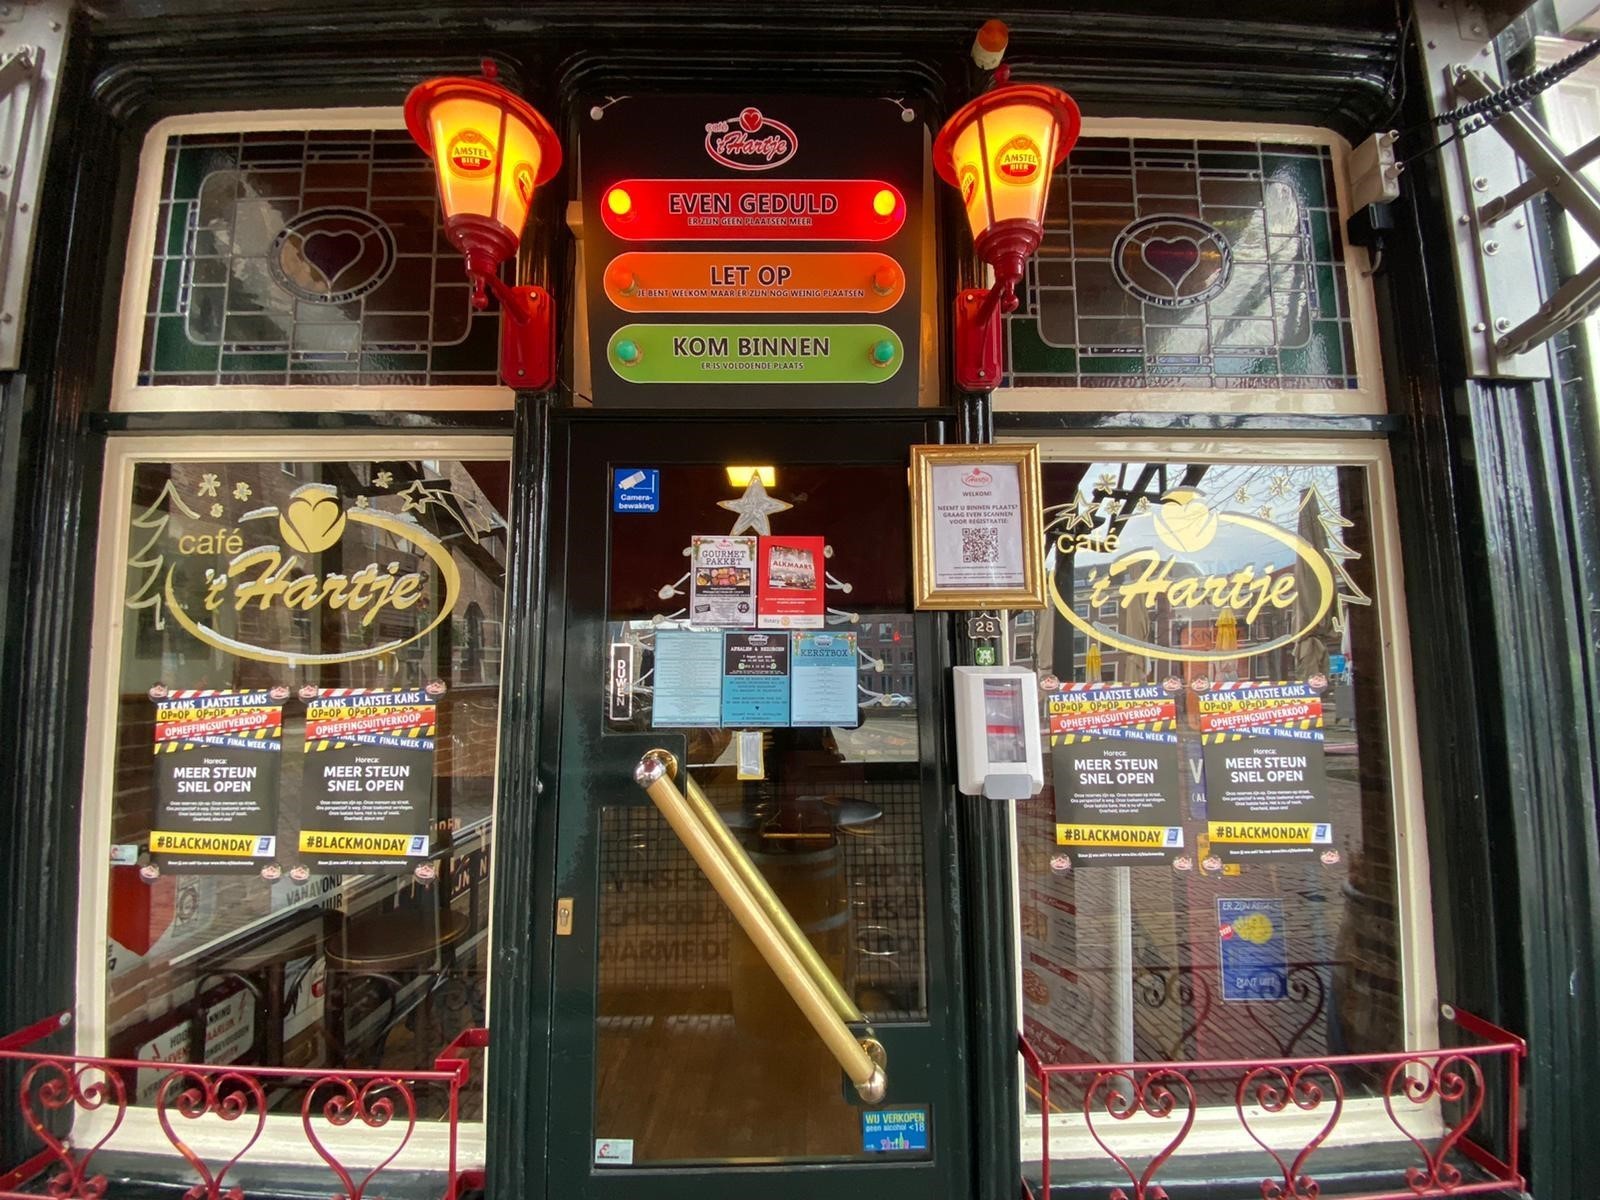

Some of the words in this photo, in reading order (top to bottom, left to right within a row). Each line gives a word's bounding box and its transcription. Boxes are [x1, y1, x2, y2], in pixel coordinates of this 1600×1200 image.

[722, 132, 787, 160] Hartje
[454, 147, 488, 158] AMSTEL
[1004, 153, 1036, 163] AMSTEL
[461, 157, 480, 165] BIER
[668, 193, 730, 214] EVEN
[739, 193, 838, 214] GEDULD
[688, 217, 699, 226] ER
[722, 217, 742, 226] GEEN
[745, 217, 787, 226] PLAATSEN
[789, 217, 812, 226] MEER
[711, 266, 749, 285] LET
[758, 266, 791, 285] OP
[637, 289, 647, 297] JE
[648, 289, 669, 297] BENT
[672, 289, 708, 297] WELKOM
[710, 289, 735, 297] MAAR
[737, 289, 748, 297] ER
[750, 289, 768, 297] ZIJN
[770, 289, 788, 297] NOG
[790, 289, 820, 297] WEINIG
[823, 289, 864, 297] PLAATSEN
[673, 337, 729, 357] KOM
[738, 337, 830, 357] BINNEN
[701, 362, 711, 370] ER
[713, 362, 720, 370] IS
[723, 362, 772, 370] VOLDOENDE
[774, 362, 804, 370] PLAATS
[620, 493, 653, 501] Camera-
[619, 502, 654, 511] bewaking
[178, 528, 243, 554] café
[1057, 528, 1120, 553] café
[702, 550, 746, 558] GOURMET
[773, 560, 813, 570] ALKMAARS
[205, 569, 227, 610] 't
[228, 546, 422, 626] Hartje
[1088, 567, 1111, 608] 't
[1109, 549, 1298, 625] Hartje
[975, 621, 995, 633] 28
[800, 649, 848, 657] KERSTBOX
[616, 660, 627, 706] DUWEN
[1062, 693, 1087, 701] KANS
[1093, 689, 1132, 700] LAATSTE
[1134, 687, 1158, 698] KANS
[1212, 692, 1236, 700] KANS
[1242, 688, 1279, 700] LAATSTE
[1281, 686, 1305, 697] KANS
[170, 700, 195, 708] KANS
[201, 697, 240, 708] LAATSTE
[242, 694, 267, 705] KANS
[321, 699, 346, 708] KANS
[353, 695, 392, 707] LAATSTE
[394, 693, 419, 704] KANS
[1203, 702, 1233, 711] OP=OP
[1053, 703, 1083, 711] OP=OP
[161, 710, 190, 719] OP=OP
[311, 709, 341, 718] OP=OP
[1060, 707, 1162, 728] OPHEFFINGSUITVERKOOP
[1211, 706, 1309, 728] OPHEFFINGSUITVERKOOP
[165, 715, 267, 736] OPHEFFINGSUITVERKOOP
[316, 713, 421, 735] OPHEFFINGSUITVERKOOP
[1102, 728, 1121, 737] WEEK
[1125, 730, 1144, 739] FINAL
[1145, 733, 1163, 741] WEEK
[1252, 727, 1270, 735] WEEK
[1274, 728, 1292, 738] FINAL
[1294, 731, 1312, 739] WEEK
[206, 736, 224, 744] WEEK
[227, 738, 245, 747] FINAL
[247, 741, 266, 749] WEEK
[357, 734, 376, 743] WEEK
[379, 736, 398, 746] FINAL
[401, 739, 419, 747] WEEK
[1074, 759, 1111, 770] MEER
[1114, 759, 1158, 770] STEUN
[1225, 758, 1262, 769] MEER
[1264, 757, 1307, 768] STEUN
[174, 767, 210, 778] MEER
[213, 767, 257, 778] STEUN
[324, 766, 362, 777] MEER
[364, 765, 410, 777] STEUN
[1231, 771, 1264, 783] SNEL
[1266, 770, 1303, 782] OPEN
[1079, 773, 1114, 784] SNEL
[1116, 773, 1154, 784] OPEN
[177, 781, 210, 792] SNEL
[213, 781, 251, 792] OPEN
[327, 780, 363, 791] SNEL
[365, 780, 404, 791] OPEN
[1064, 828, 1161, 842] #BLACKMONDAY
[1216, 826, 1310, 839] #BLACKMONDAY
[157, 837, 252, 852] #BLACKMONDAY
[307, 836, 406, 851] #BLACKMONDAY
[882, 1112, 925, 1124] VERKOPEN
